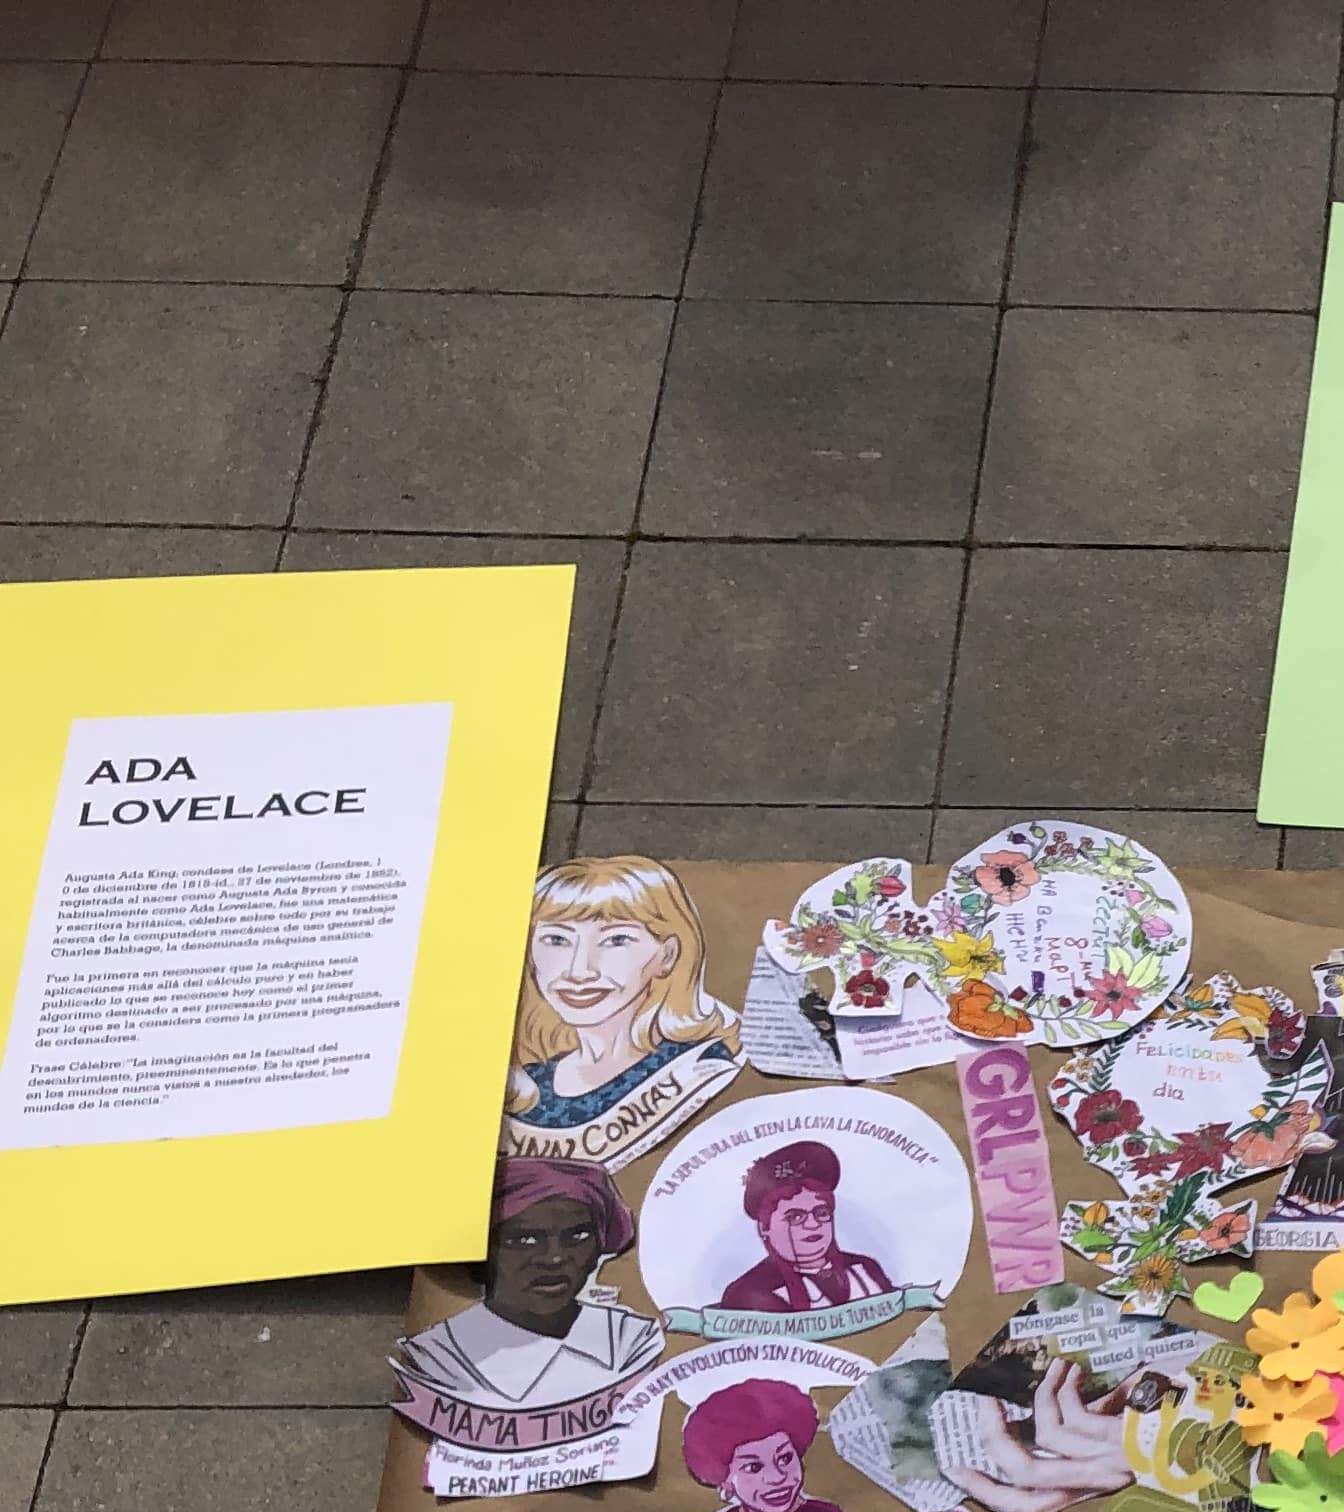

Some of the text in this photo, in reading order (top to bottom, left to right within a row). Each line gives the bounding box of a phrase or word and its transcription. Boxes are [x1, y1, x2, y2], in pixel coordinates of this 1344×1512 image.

[86, 757, 196, 784] ADA
[79, 788, 366, 826] LOVELACE
[582, 1077, 684, 1156] CONWAY
[966, 1048, 1052, 1288] GRLPWR
[712, 1302, 894, 1336] CLORINDA MATTO DE TURNER
[1014, 1304, 1103, 1334] póngase la
[1060, 1324, 1136, 1349] ropa que
[1094, 1336, 1196, 1365] usted quiera
[429, 1399, 519, 1445] MAMA
[449, 1467, 601, 1494] PEASANT HEROINE
